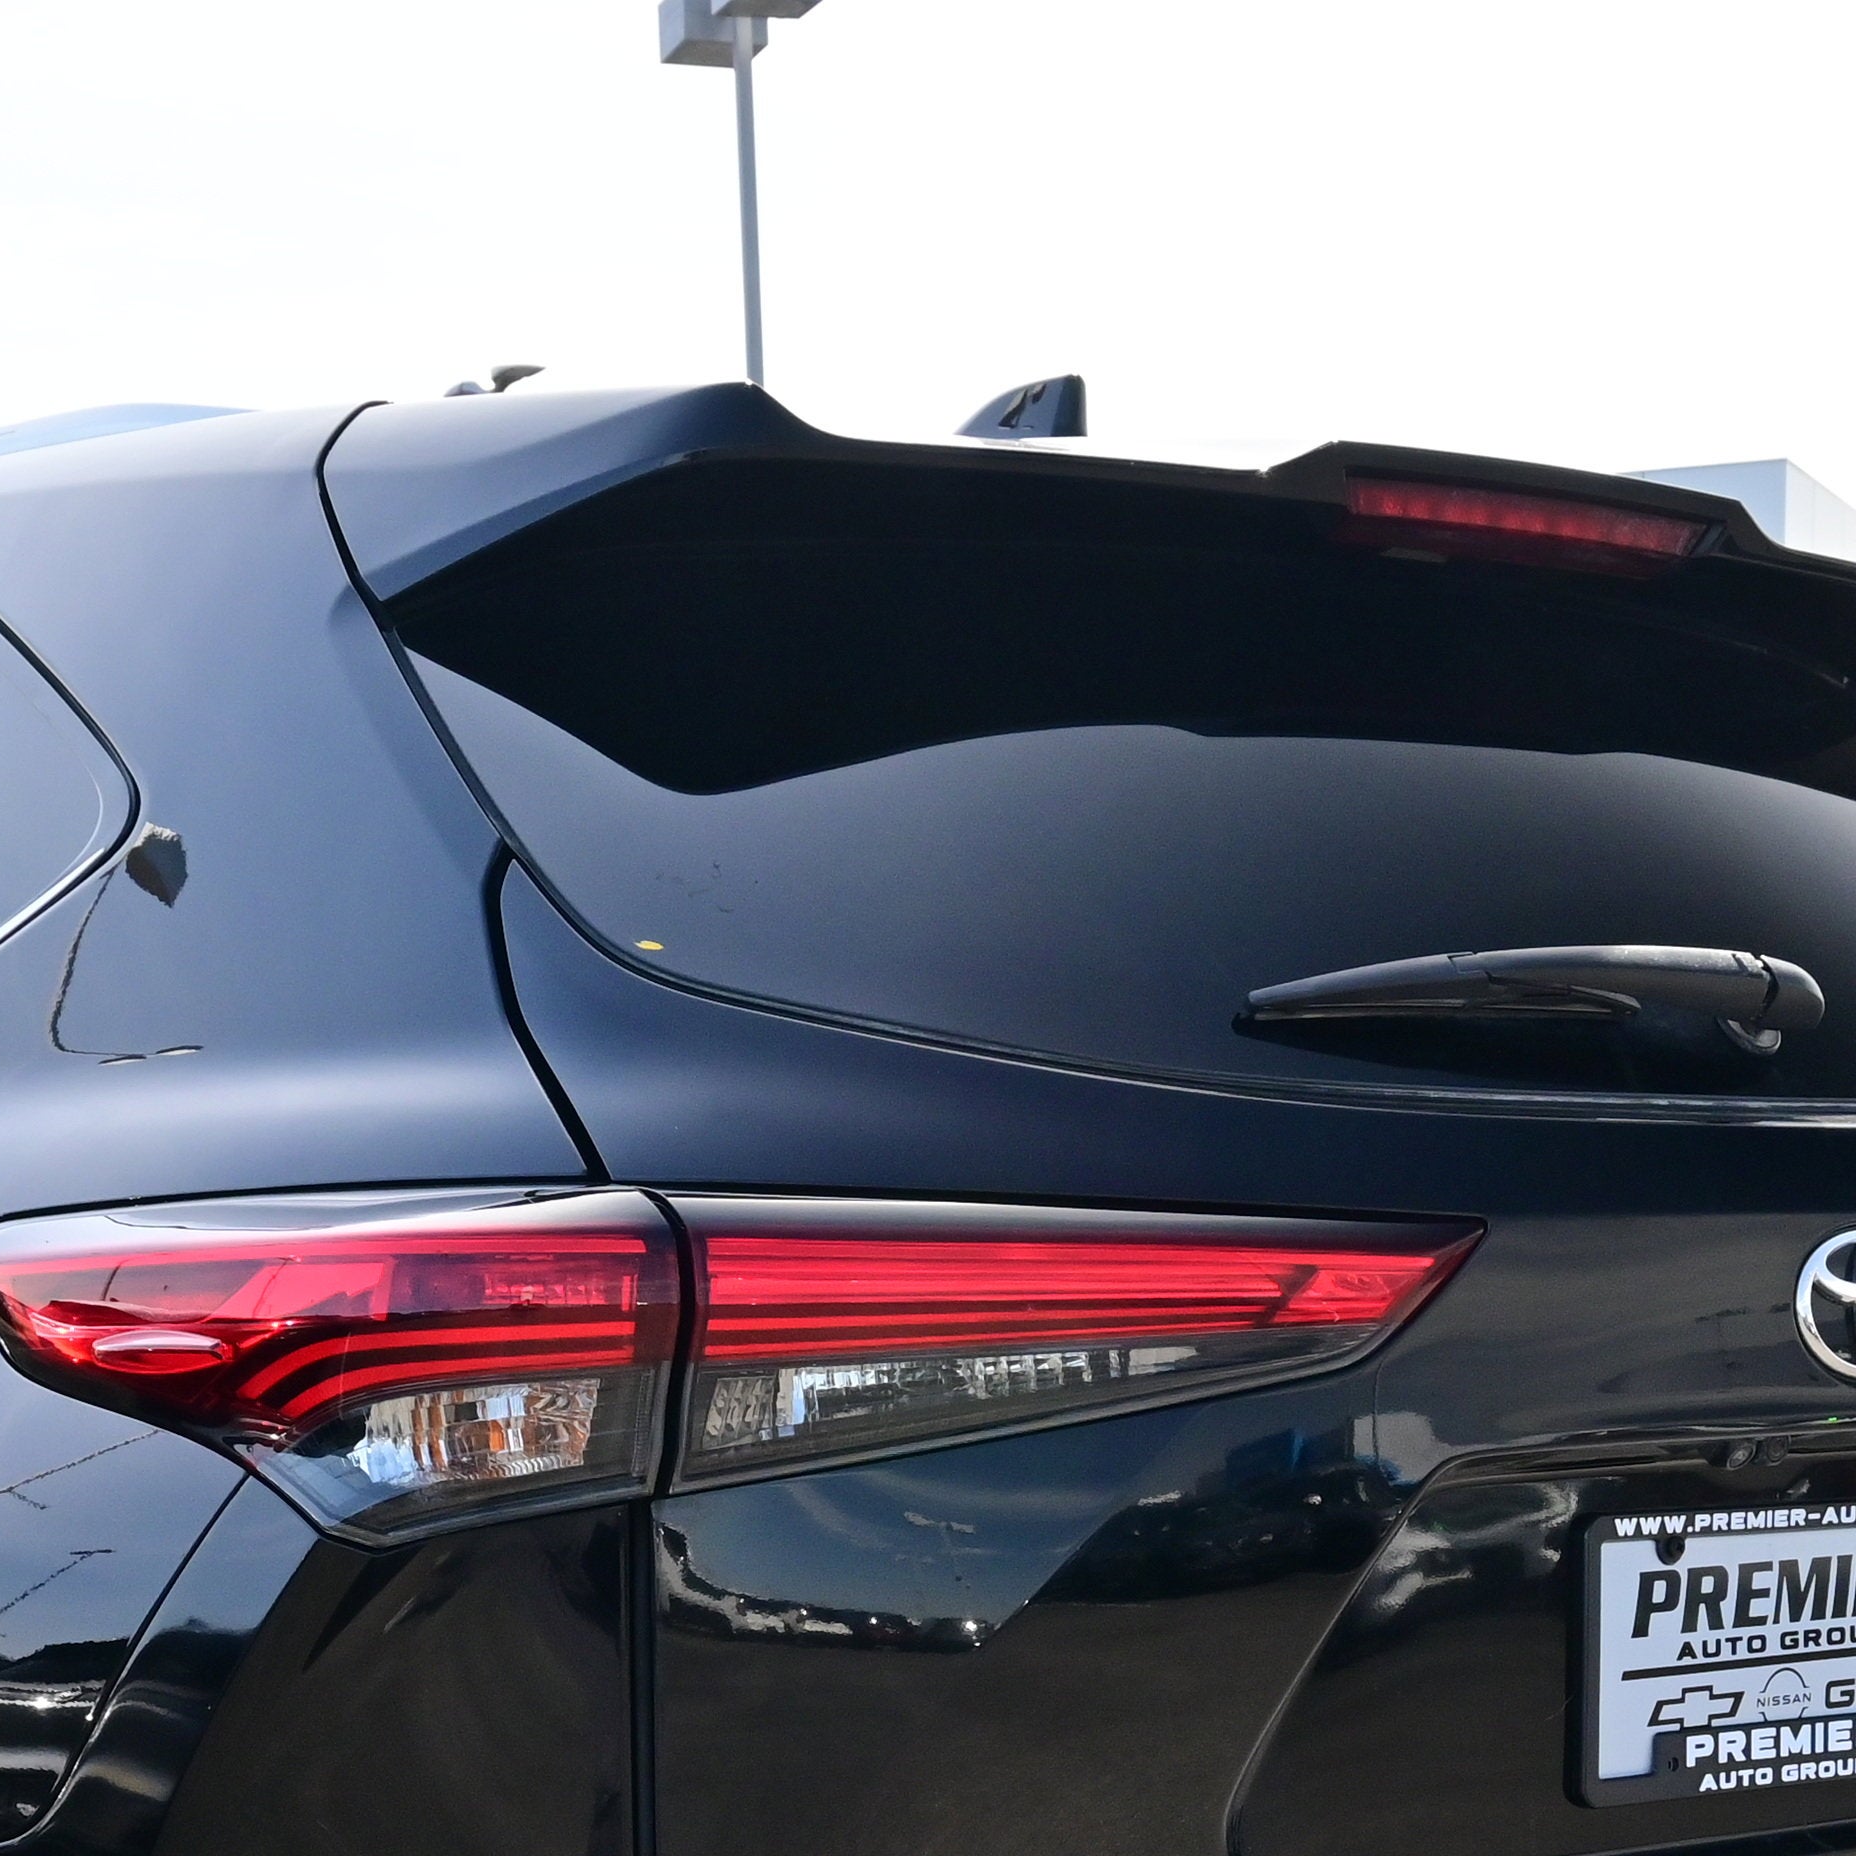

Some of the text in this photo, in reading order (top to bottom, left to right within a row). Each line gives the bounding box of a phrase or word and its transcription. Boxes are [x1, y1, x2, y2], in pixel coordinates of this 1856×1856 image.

[1676, 1634, 1768, 1662] AUTO
[1755, 1692, 1813, 1709] NISSAN
[1698, 1761, 1774, 1792] AUTO
